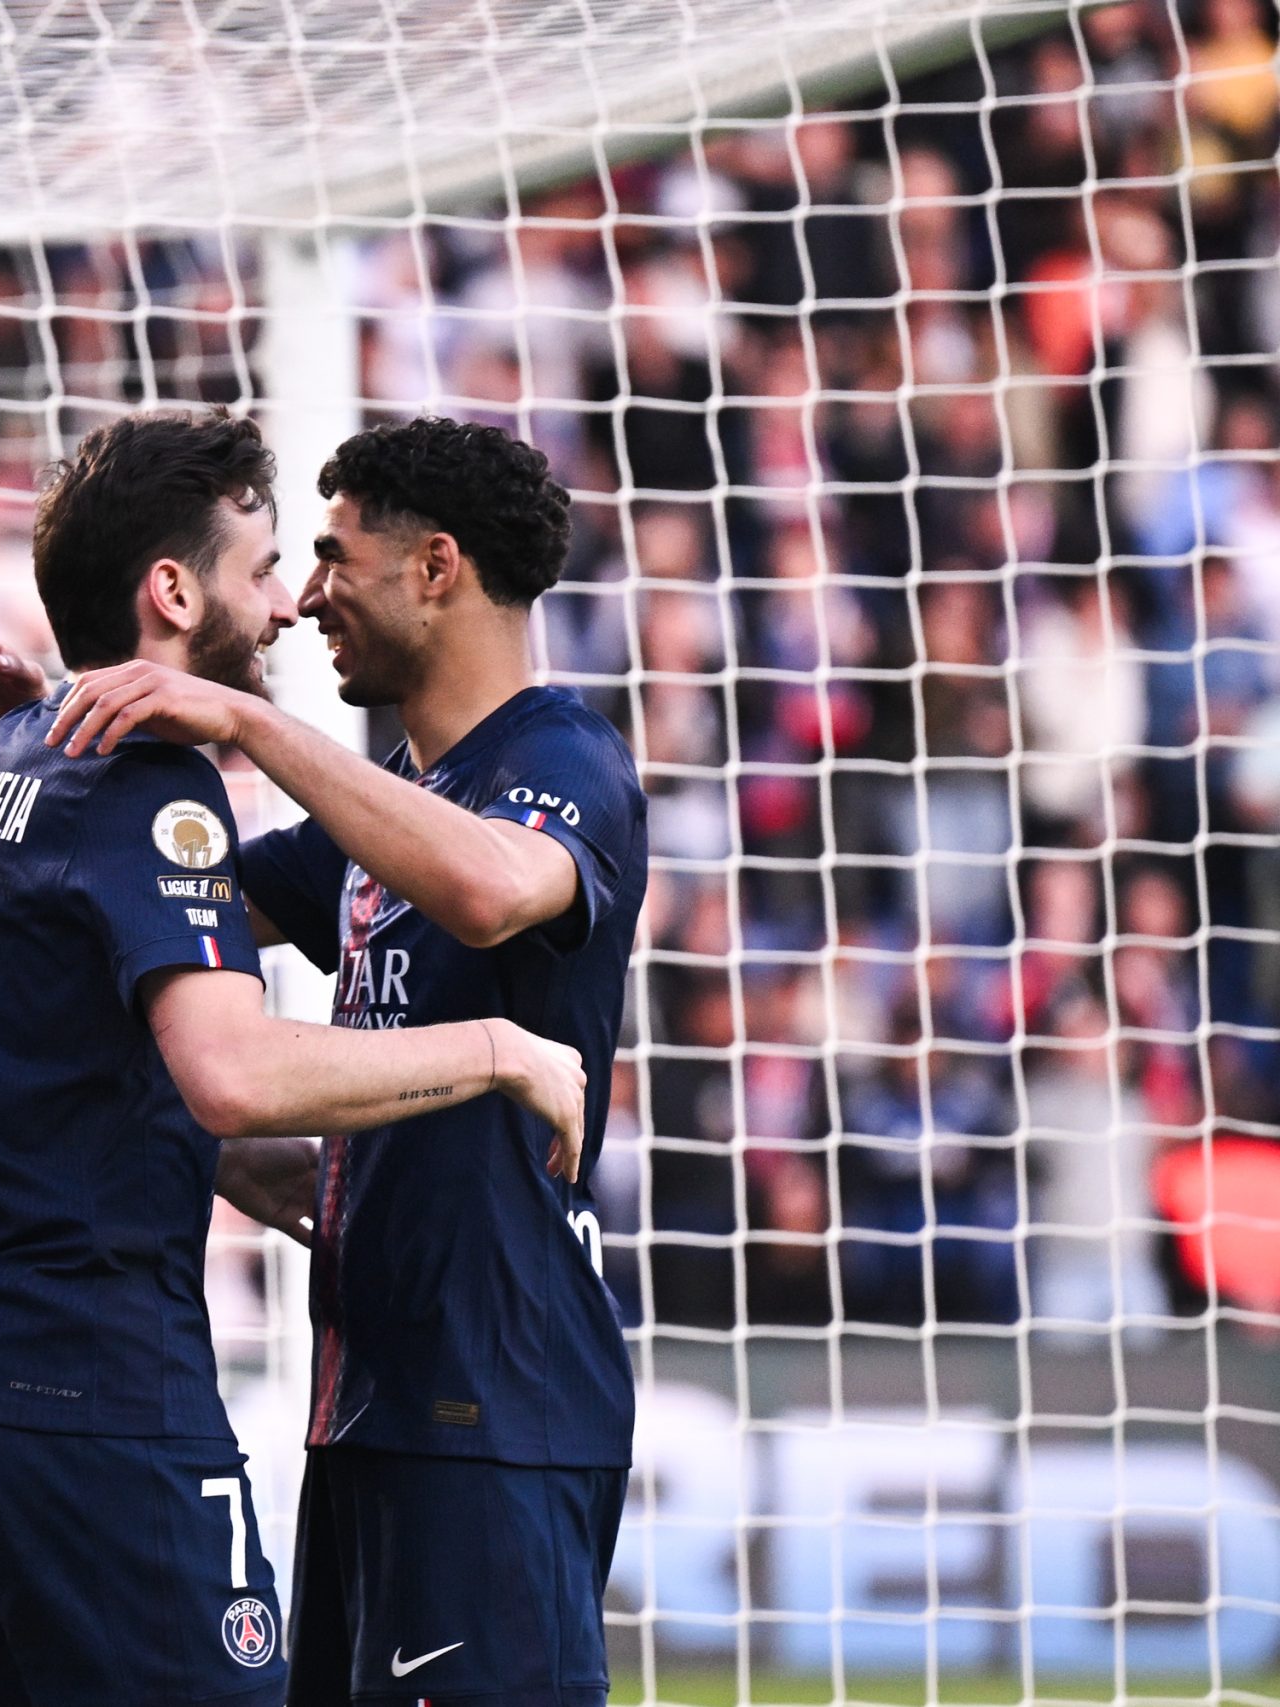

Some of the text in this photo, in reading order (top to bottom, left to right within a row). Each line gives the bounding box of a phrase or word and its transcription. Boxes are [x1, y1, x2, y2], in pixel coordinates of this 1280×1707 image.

[508, 787, 581, 826] OND
[160, 880, 198, 897] LIGUE
[201, 1477, 249, 1589] 7
[227, 1601, 263, 1621] PARIS
